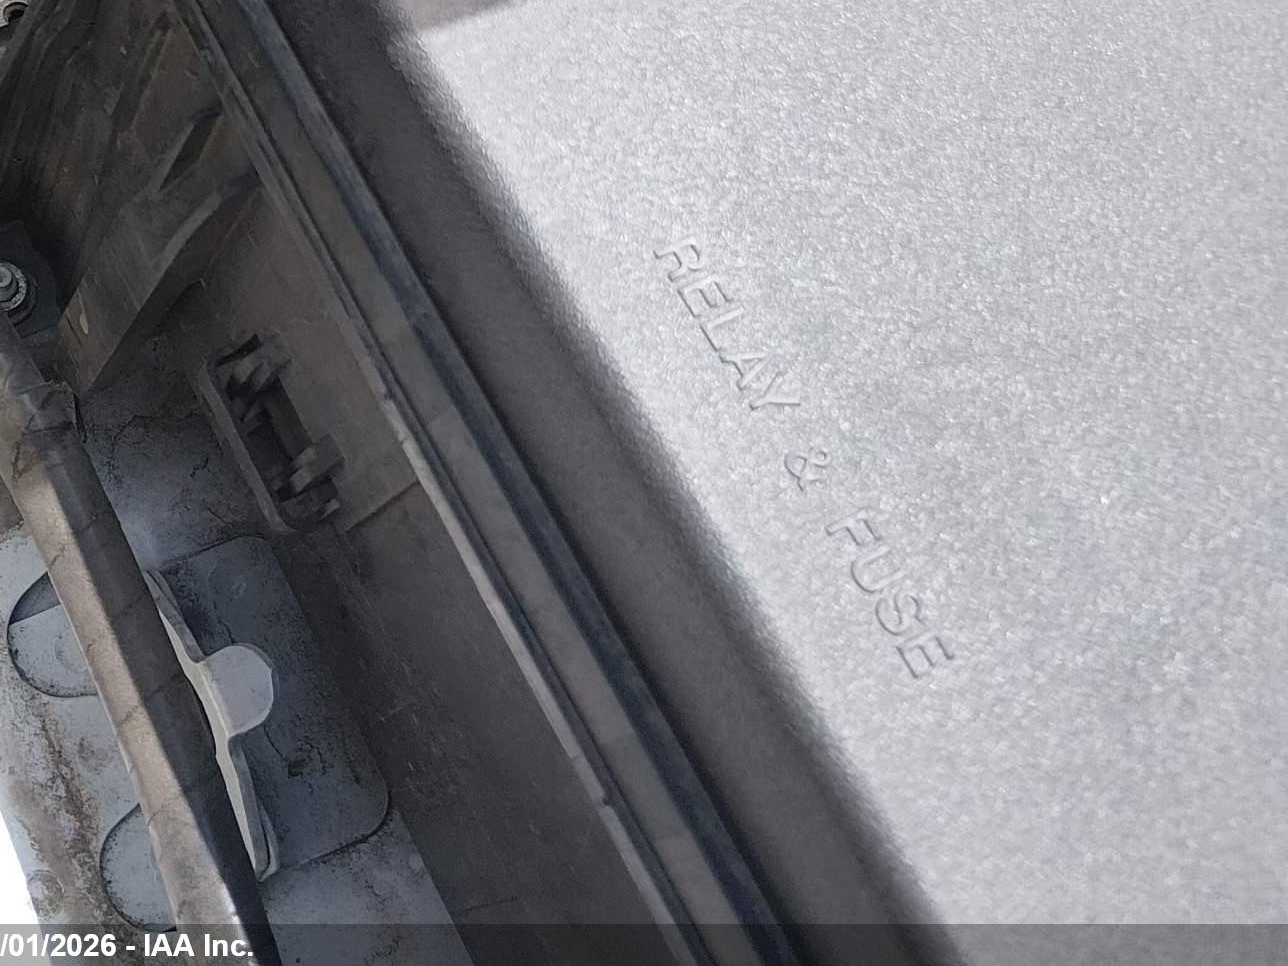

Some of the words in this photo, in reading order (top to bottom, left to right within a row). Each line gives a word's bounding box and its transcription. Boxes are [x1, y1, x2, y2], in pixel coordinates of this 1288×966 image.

[652, 238, 802, 412] RELAY
[784, 448, 831, 493] &
[824, 508, 955, 679] FUSE
